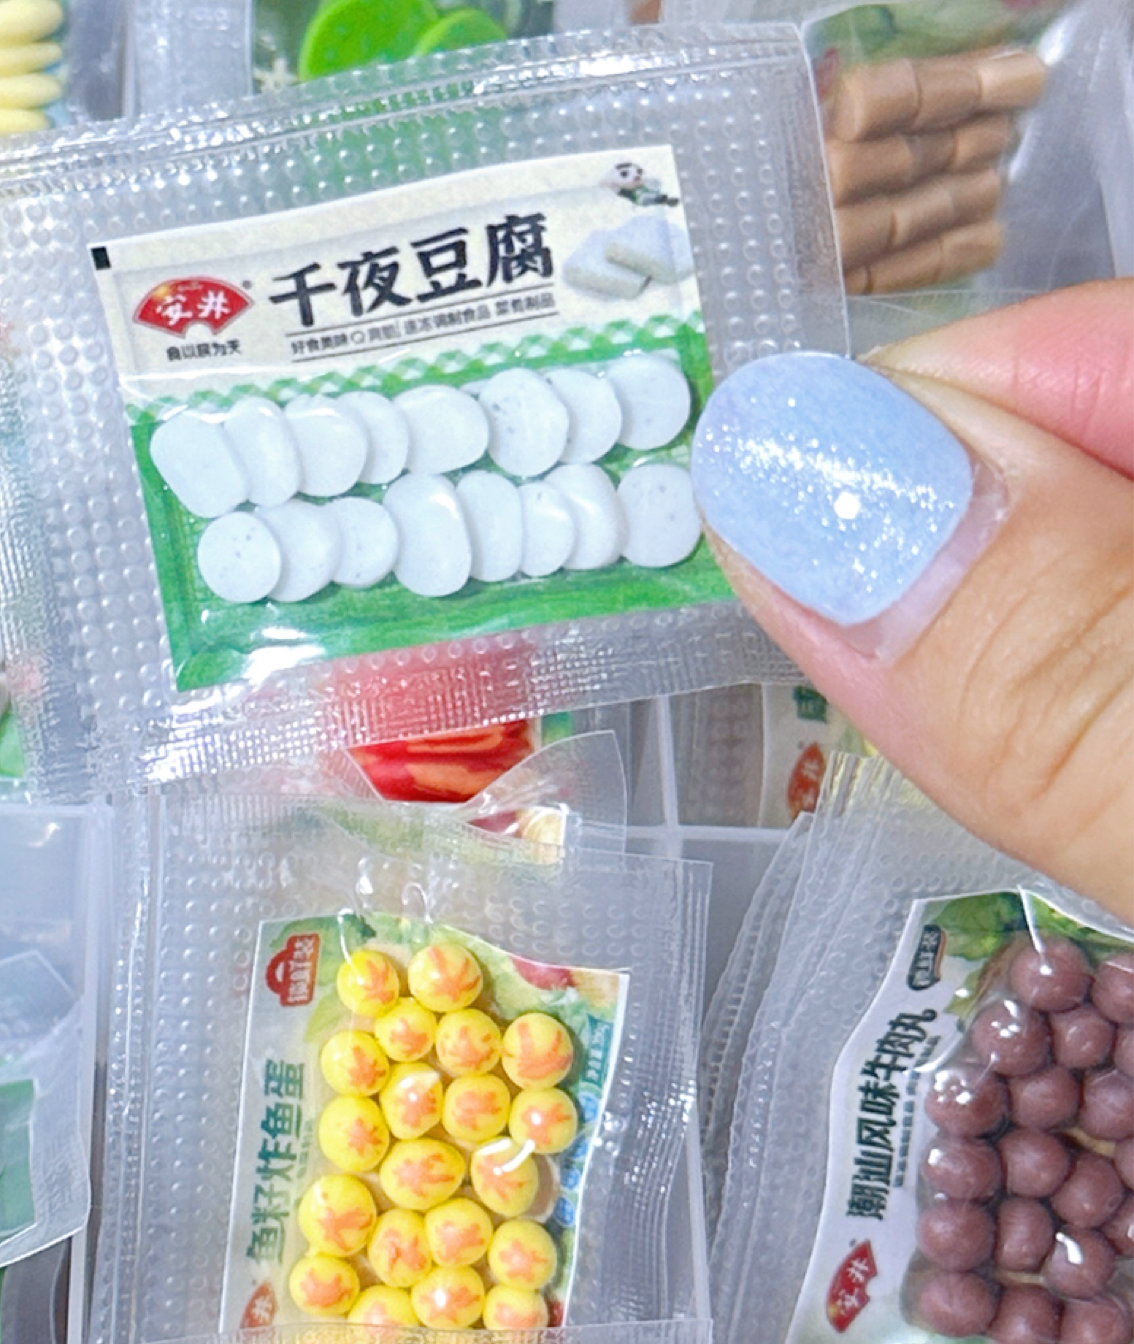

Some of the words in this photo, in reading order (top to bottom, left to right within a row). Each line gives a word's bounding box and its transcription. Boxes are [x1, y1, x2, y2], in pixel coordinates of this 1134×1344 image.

[155, 290, 232, 327] 安井
[269, 212, 555, 327] 千夜豆腐
[246, 1057, 306, 1264] 鱼籽炸鱼蛋
[845, 1008, 938, 1222] 潮汕风味牛肉丸
